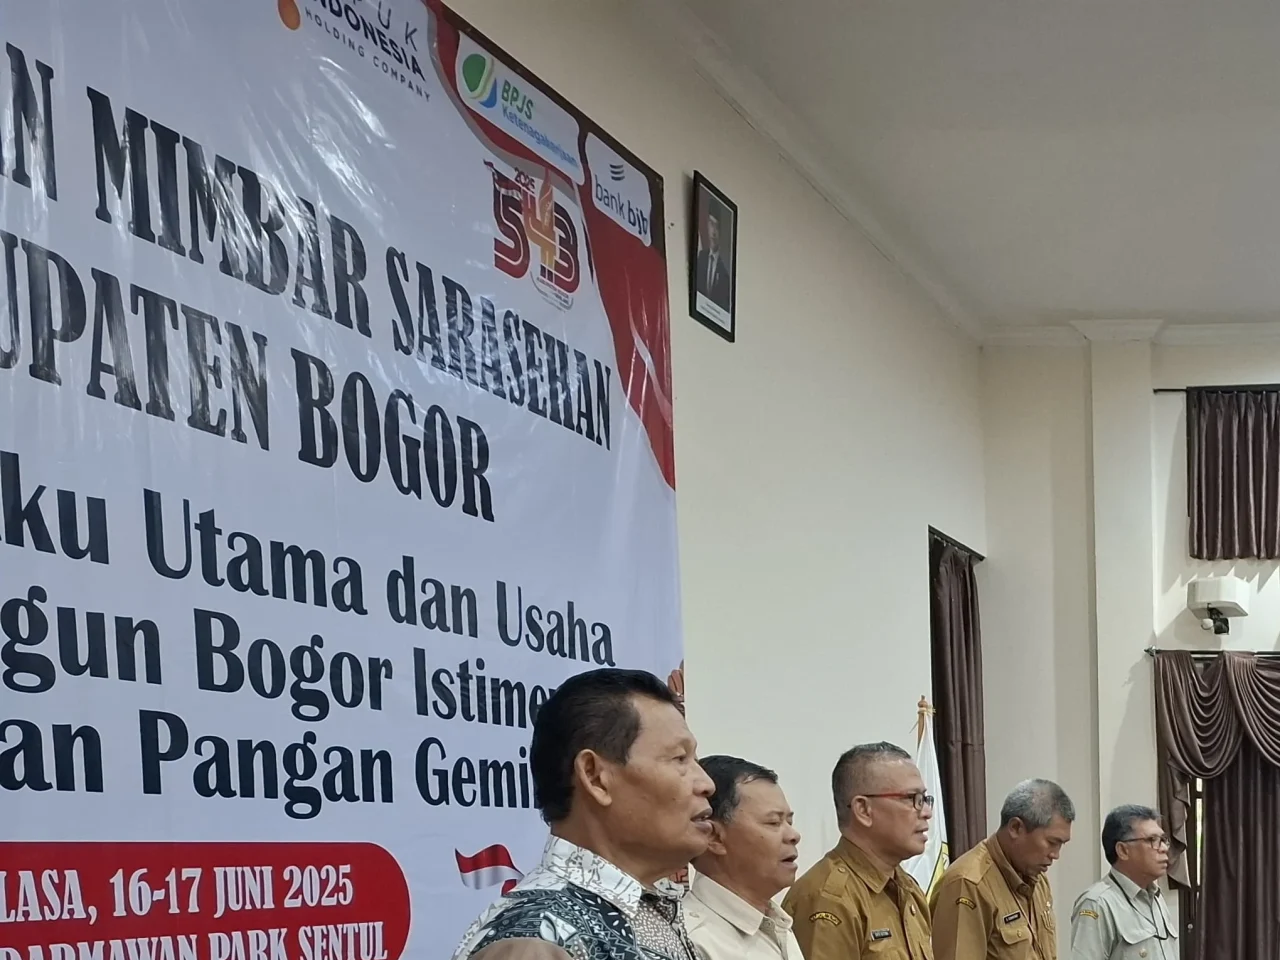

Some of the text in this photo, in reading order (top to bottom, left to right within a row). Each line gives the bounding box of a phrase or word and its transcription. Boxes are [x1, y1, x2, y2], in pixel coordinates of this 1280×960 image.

[304, 6, 431, 102] HOLDING COMPANY
[316, 0, 426, 82] DONESIA
[501, 79, 534, 121] BPJS
[513, 166, 536, 195] 2025
[594, 173, 626, 220] bank
[0, 40, 612, 451] N MIMBAR SARASEHAN
[290, 346, 495, 523] BOGOR
[0, 450, 617, 668] ku Utama dan Usaha
[193, 607, 394, 722] Bogor
[412, 646, 557, 730] Istime
[138, 708, 394, 820] Pangan
[414, 736, 542, 810] Gemi
[108, 866, 203, 917] 16-17
[212, 865, 276, 919] JUNI
[282, 863, 354, 909] 2025
